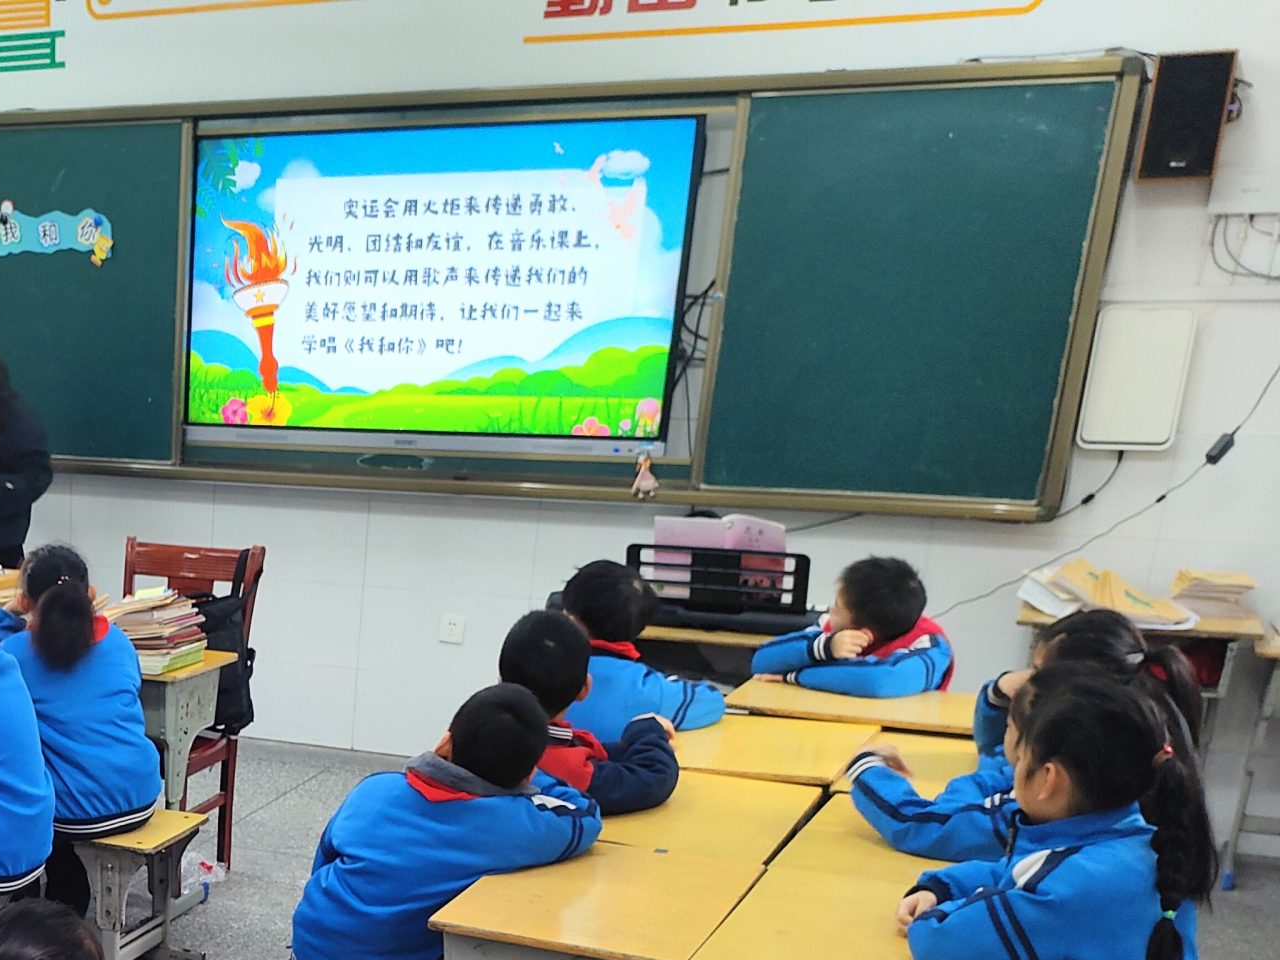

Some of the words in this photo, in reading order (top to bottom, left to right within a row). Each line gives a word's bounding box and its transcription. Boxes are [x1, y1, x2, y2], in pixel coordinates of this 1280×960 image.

[0, 217, 101, 246] 我和你
[305, 264, 588, 288] 我们则可以用歌声来传递我们的
